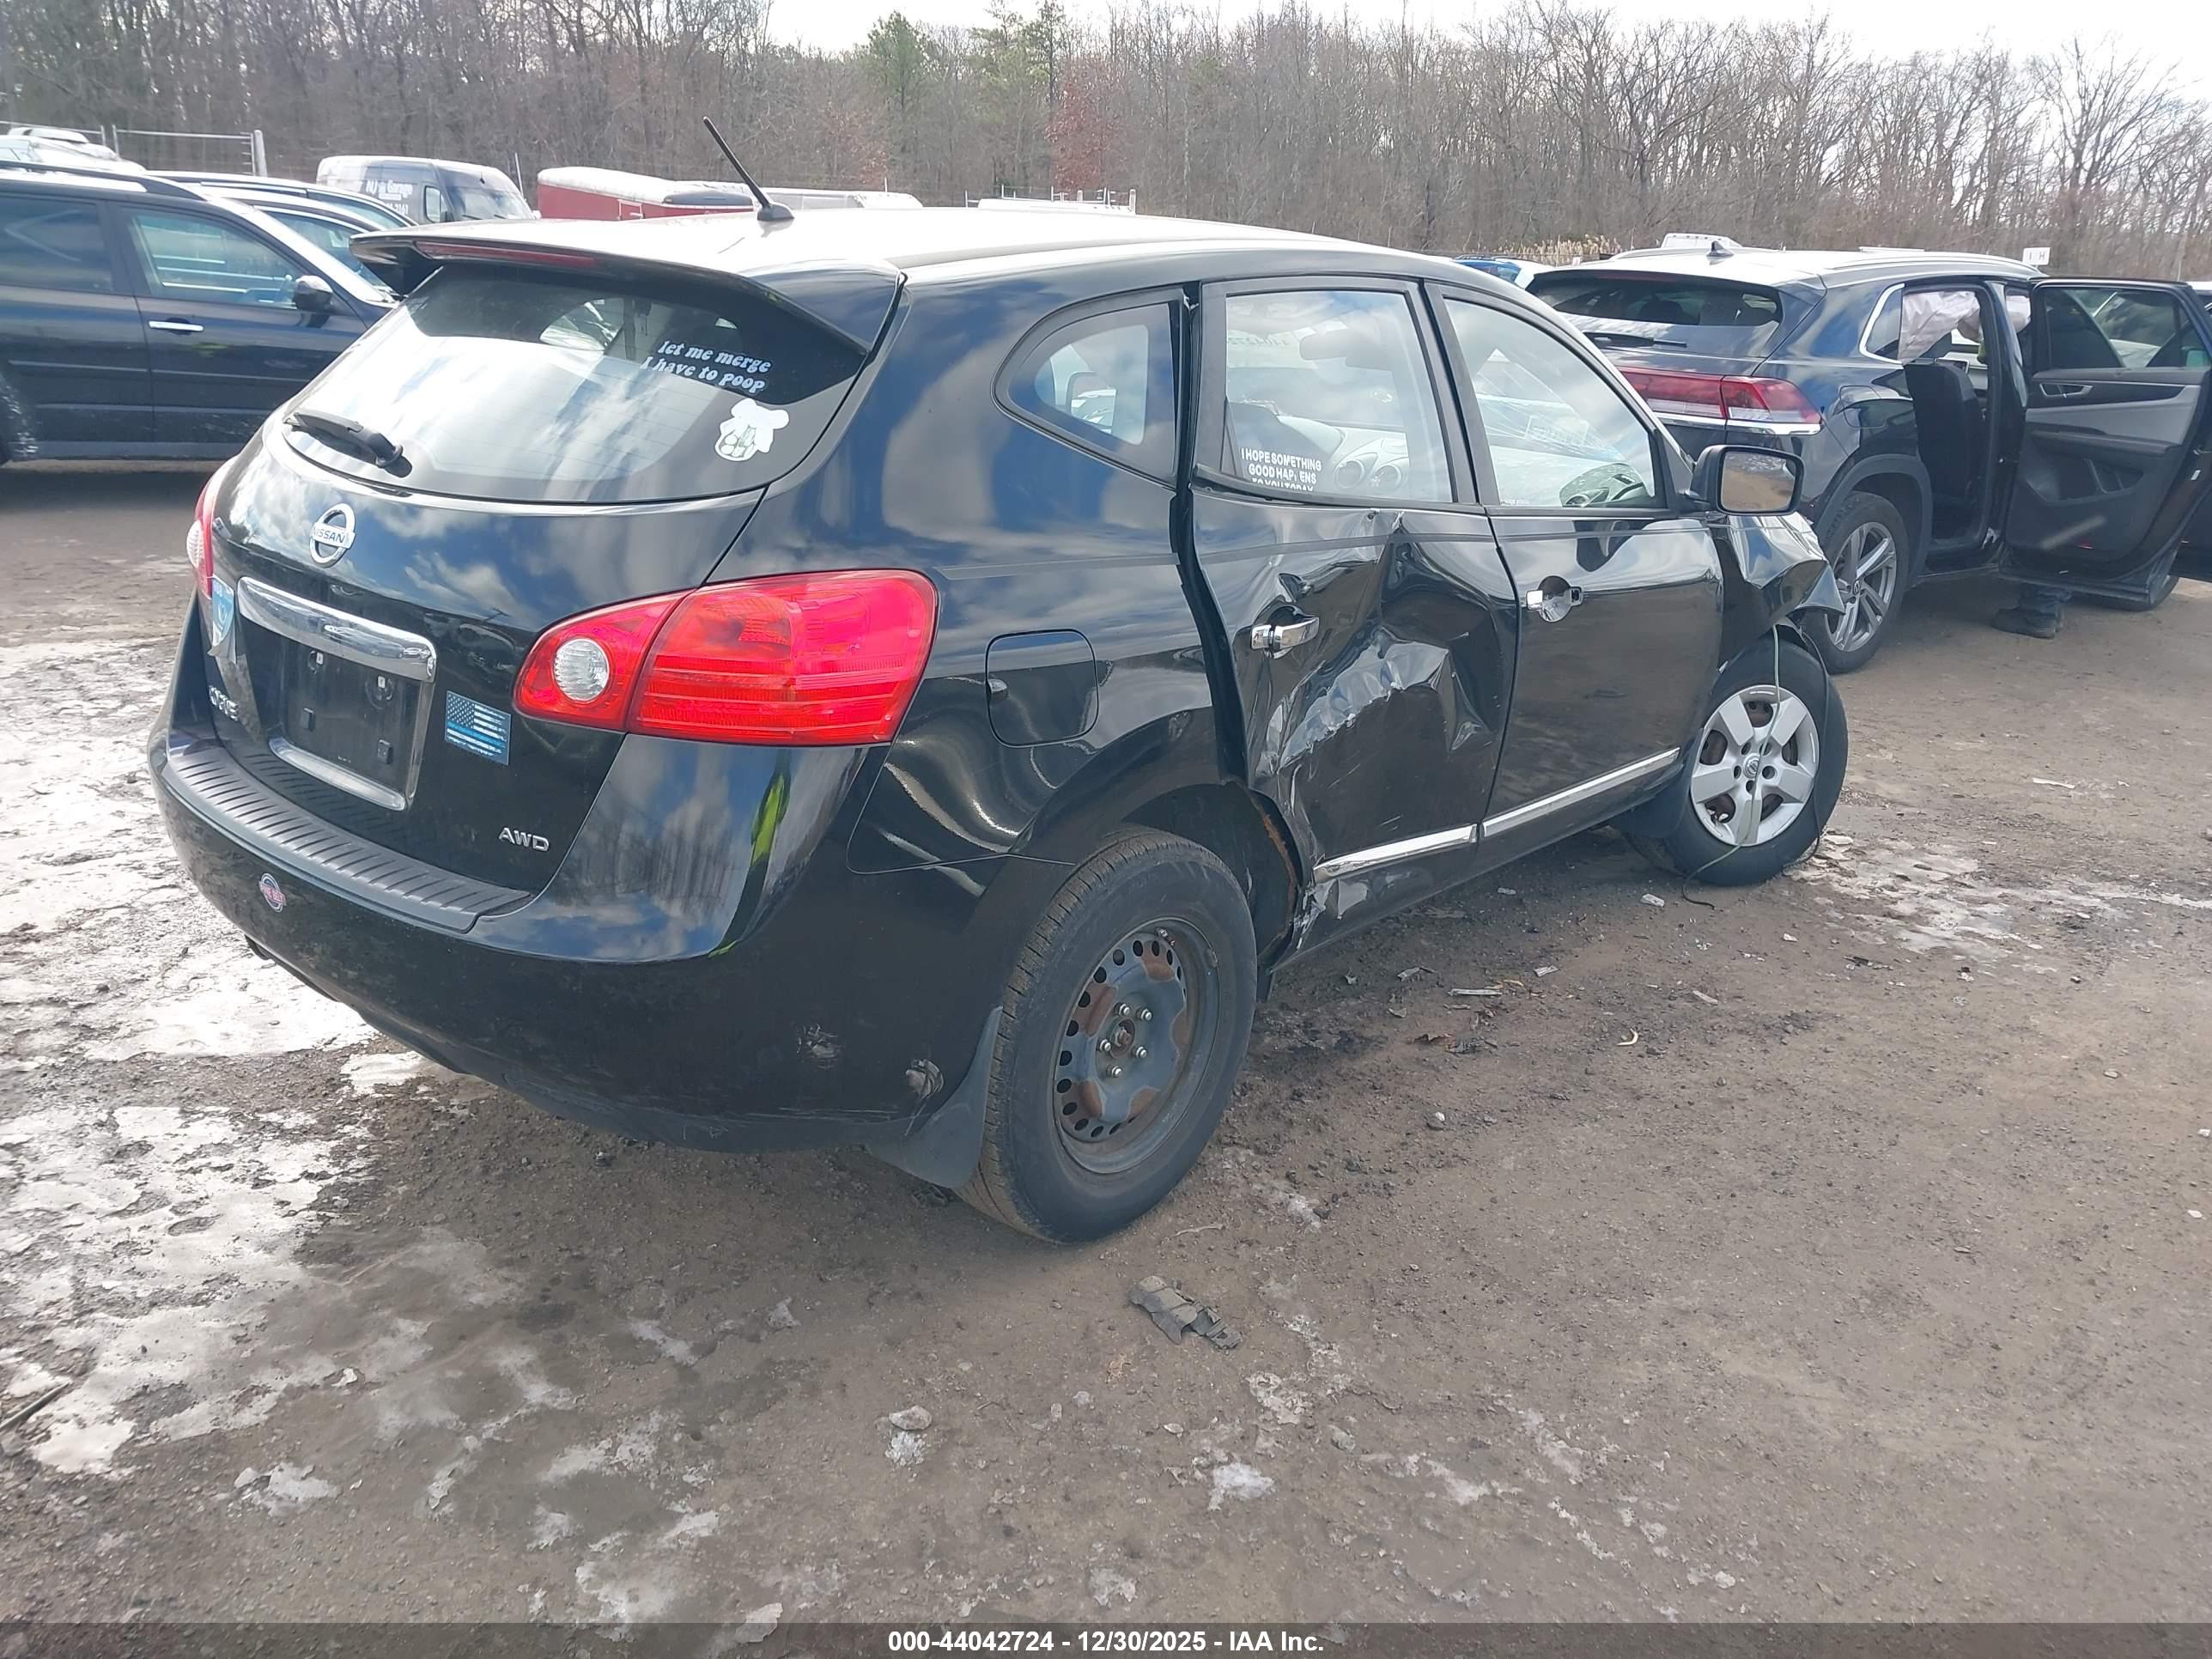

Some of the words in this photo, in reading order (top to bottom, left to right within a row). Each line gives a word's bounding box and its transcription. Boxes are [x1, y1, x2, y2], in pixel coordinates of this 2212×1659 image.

[641, 356, 653, 369] I
[653, 358, 696, 376] have
[698, 366, 718, 380] to
[658, 341, 685, 356] let
[685, 347, 714, 361] me
[714, 352, 771, 374] merge
[1241, 447, 1244, 459] I
[1245, 448, 1271, 464] HOPE
[1271, 452, 1322, 471] SOMETHING
[1249, 463, 1275, 477] GOOD
[1276, 466, 1316, 484] HAPENS
[499, 827, 550, 851] AWD
